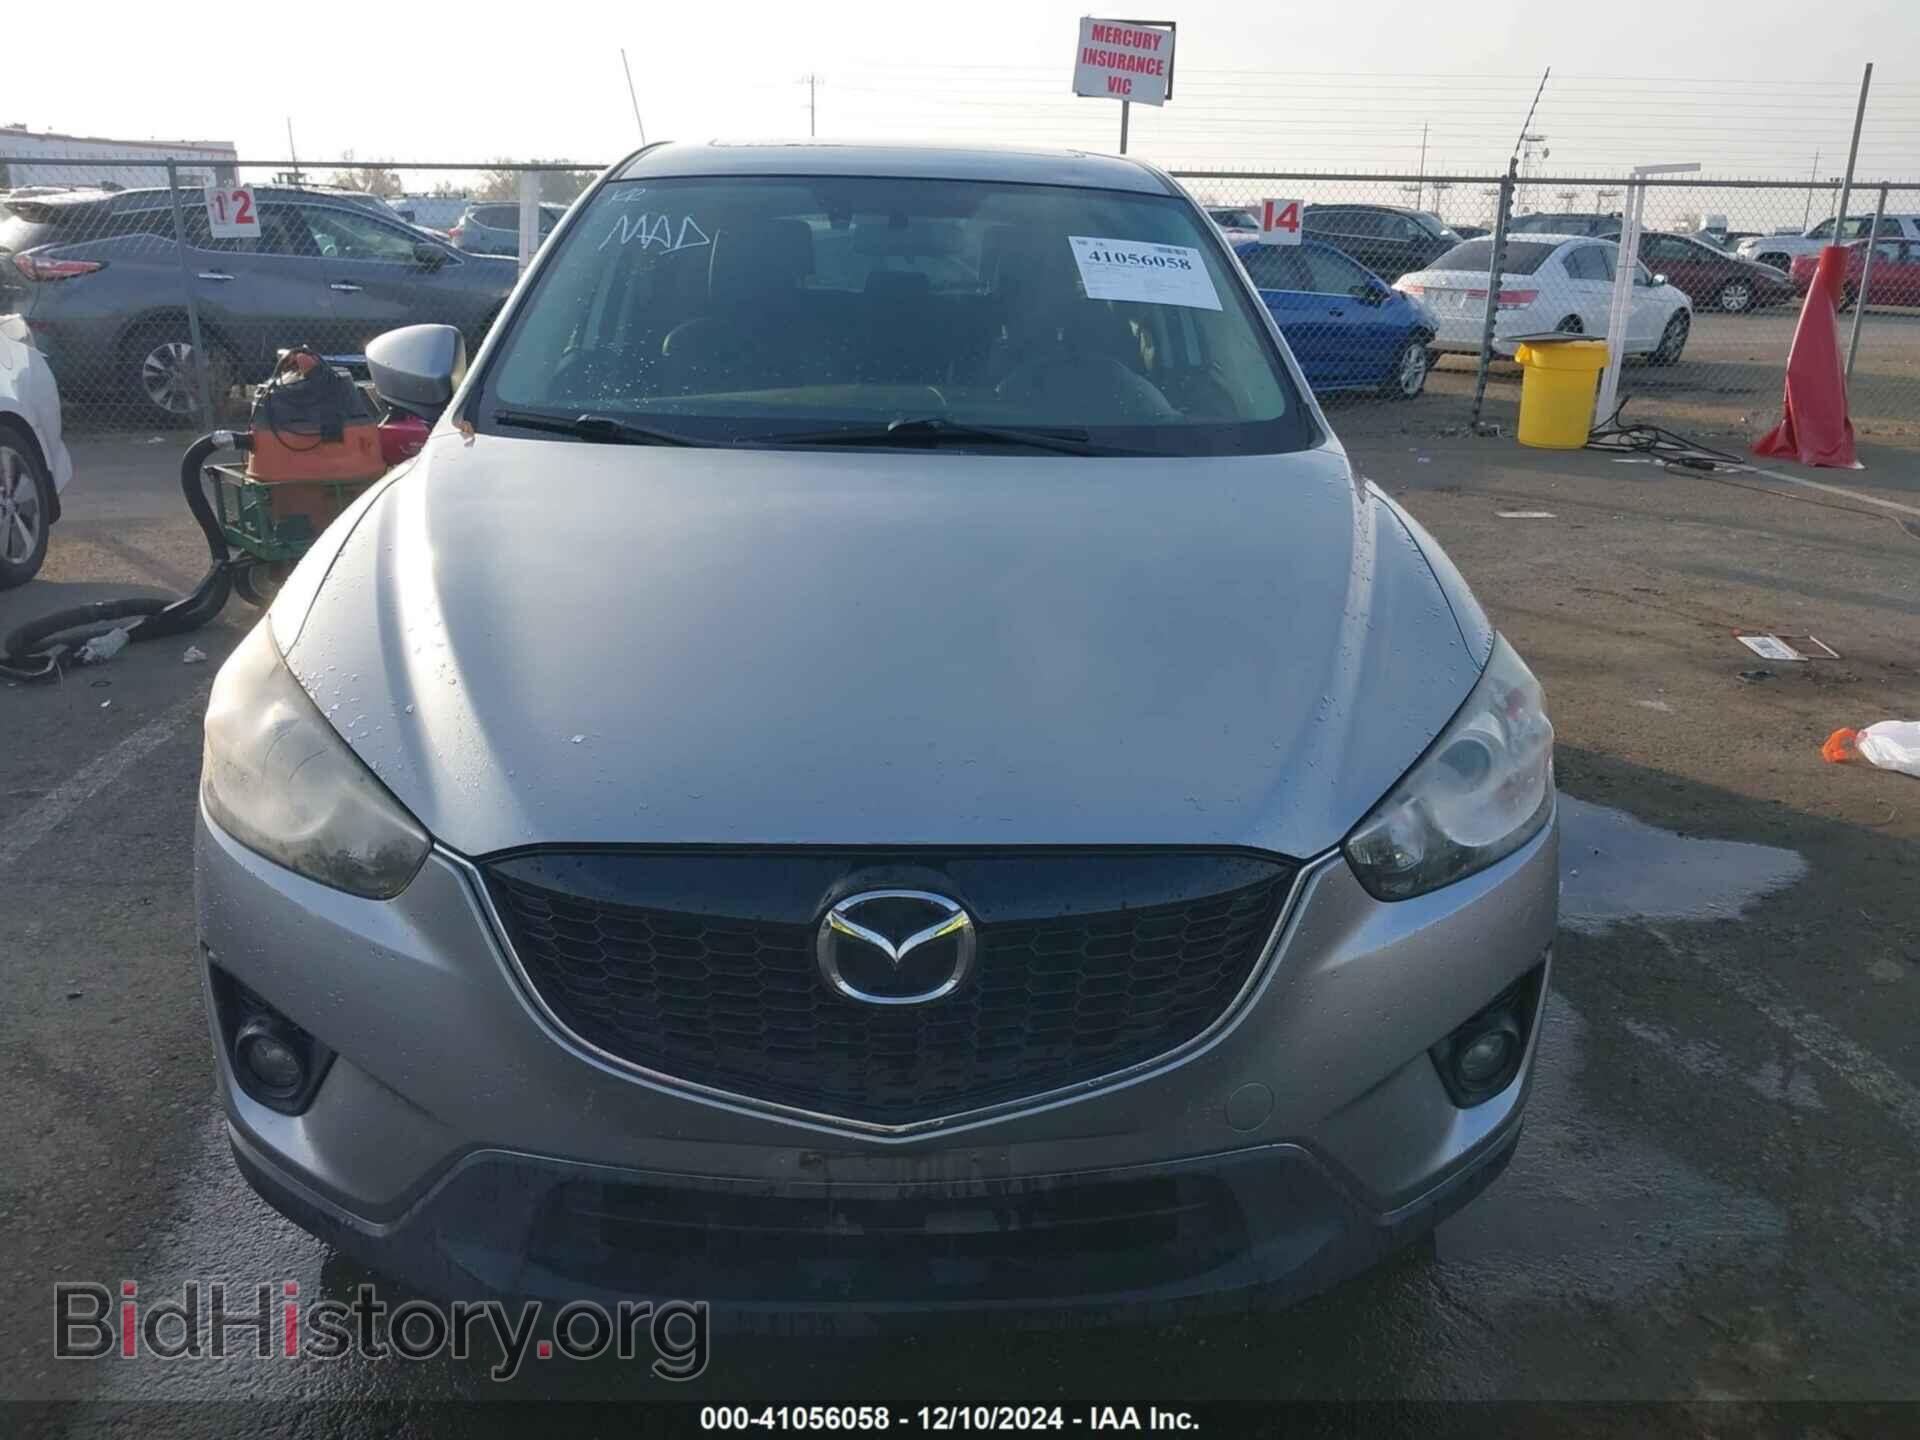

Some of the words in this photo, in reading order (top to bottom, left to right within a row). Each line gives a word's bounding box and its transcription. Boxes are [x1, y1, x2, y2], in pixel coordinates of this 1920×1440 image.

[1091, 23, 1162, 51] MERCURY
[1081, 47, 1164, 76] INSURANCE
[1107, 75, 1132, 95] VIC
[215, 190, 256, 224] 12
[1263, 201, 1300, 233] 14
[1088, 250, 1193, 271] 41056058
